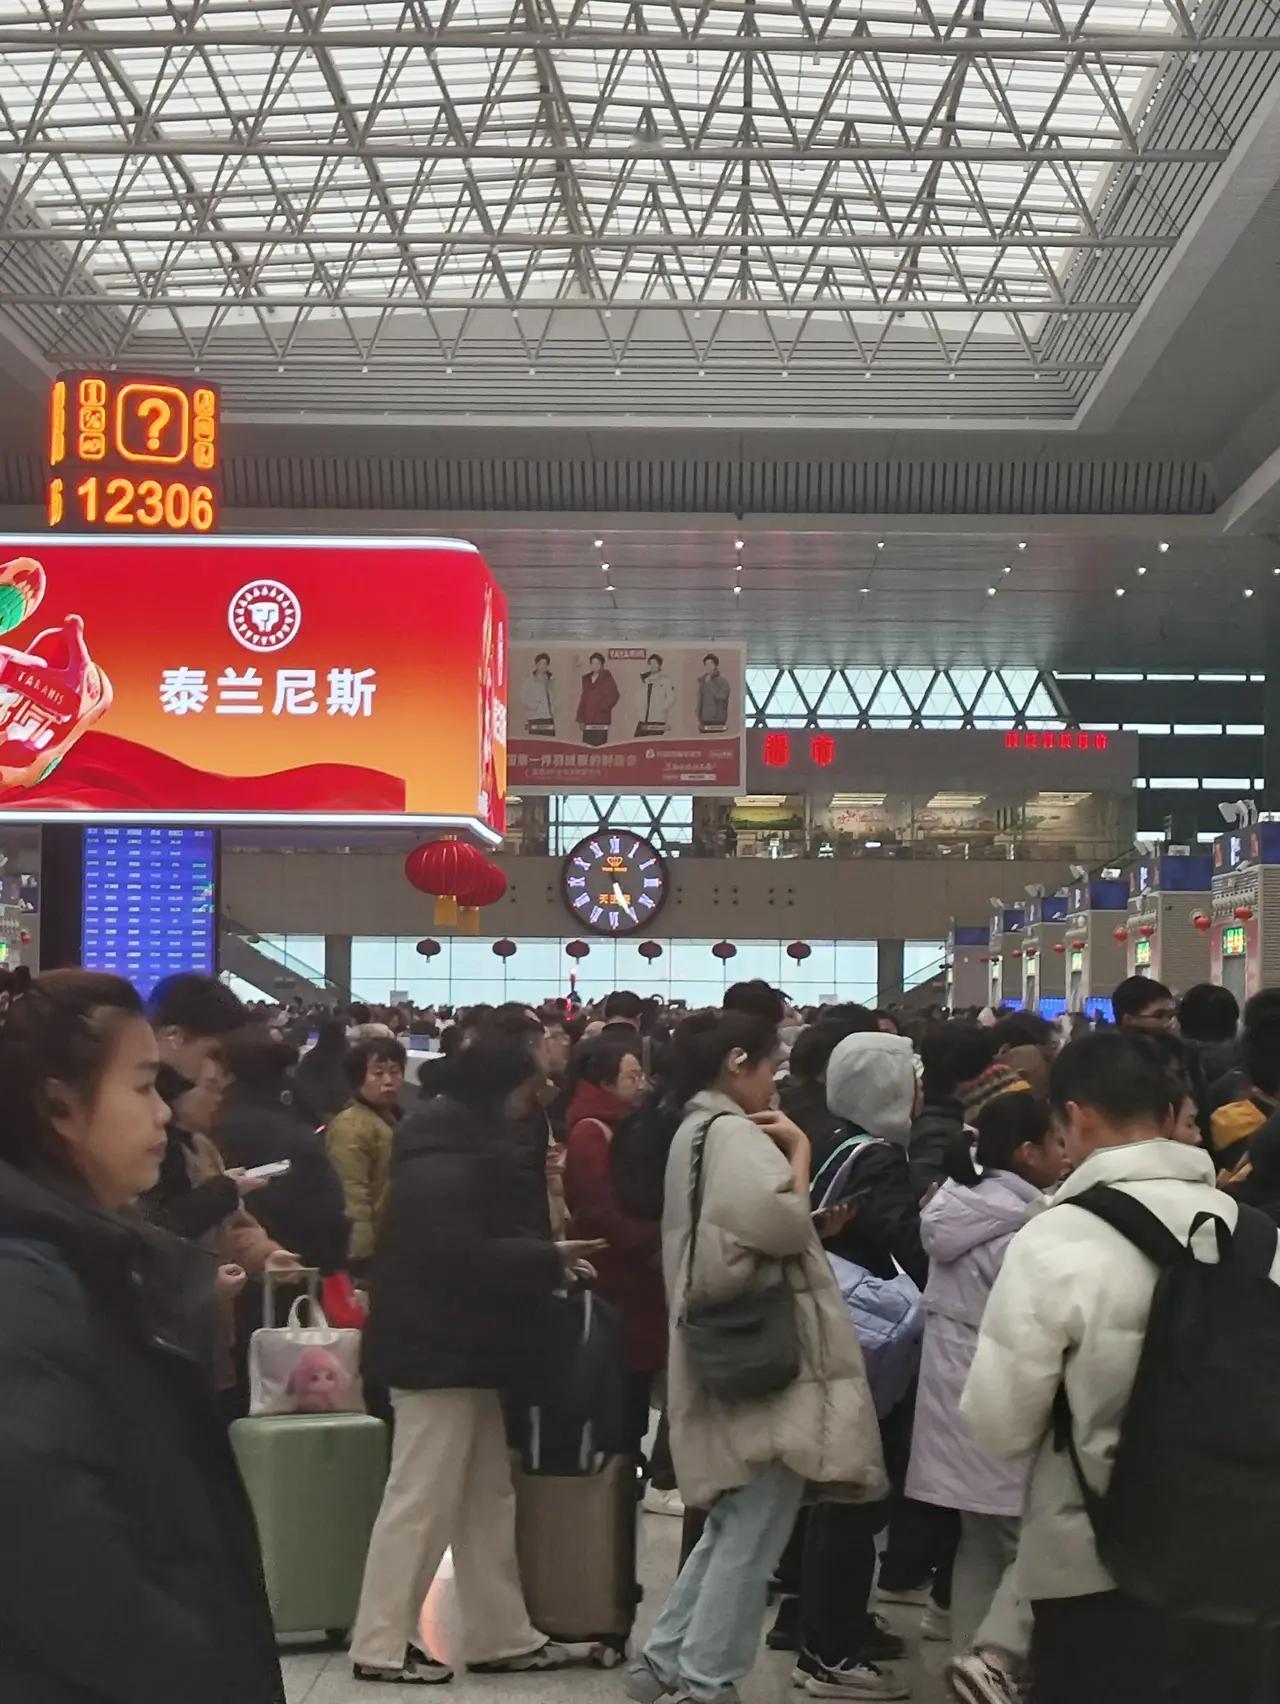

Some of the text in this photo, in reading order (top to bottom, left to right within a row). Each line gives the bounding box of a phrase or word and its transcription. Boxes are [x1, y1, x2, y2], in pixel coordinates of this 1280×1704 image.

[78, 477, 213, 531] 12306
[159, 666, 377, 717] 泰兰尼斯
